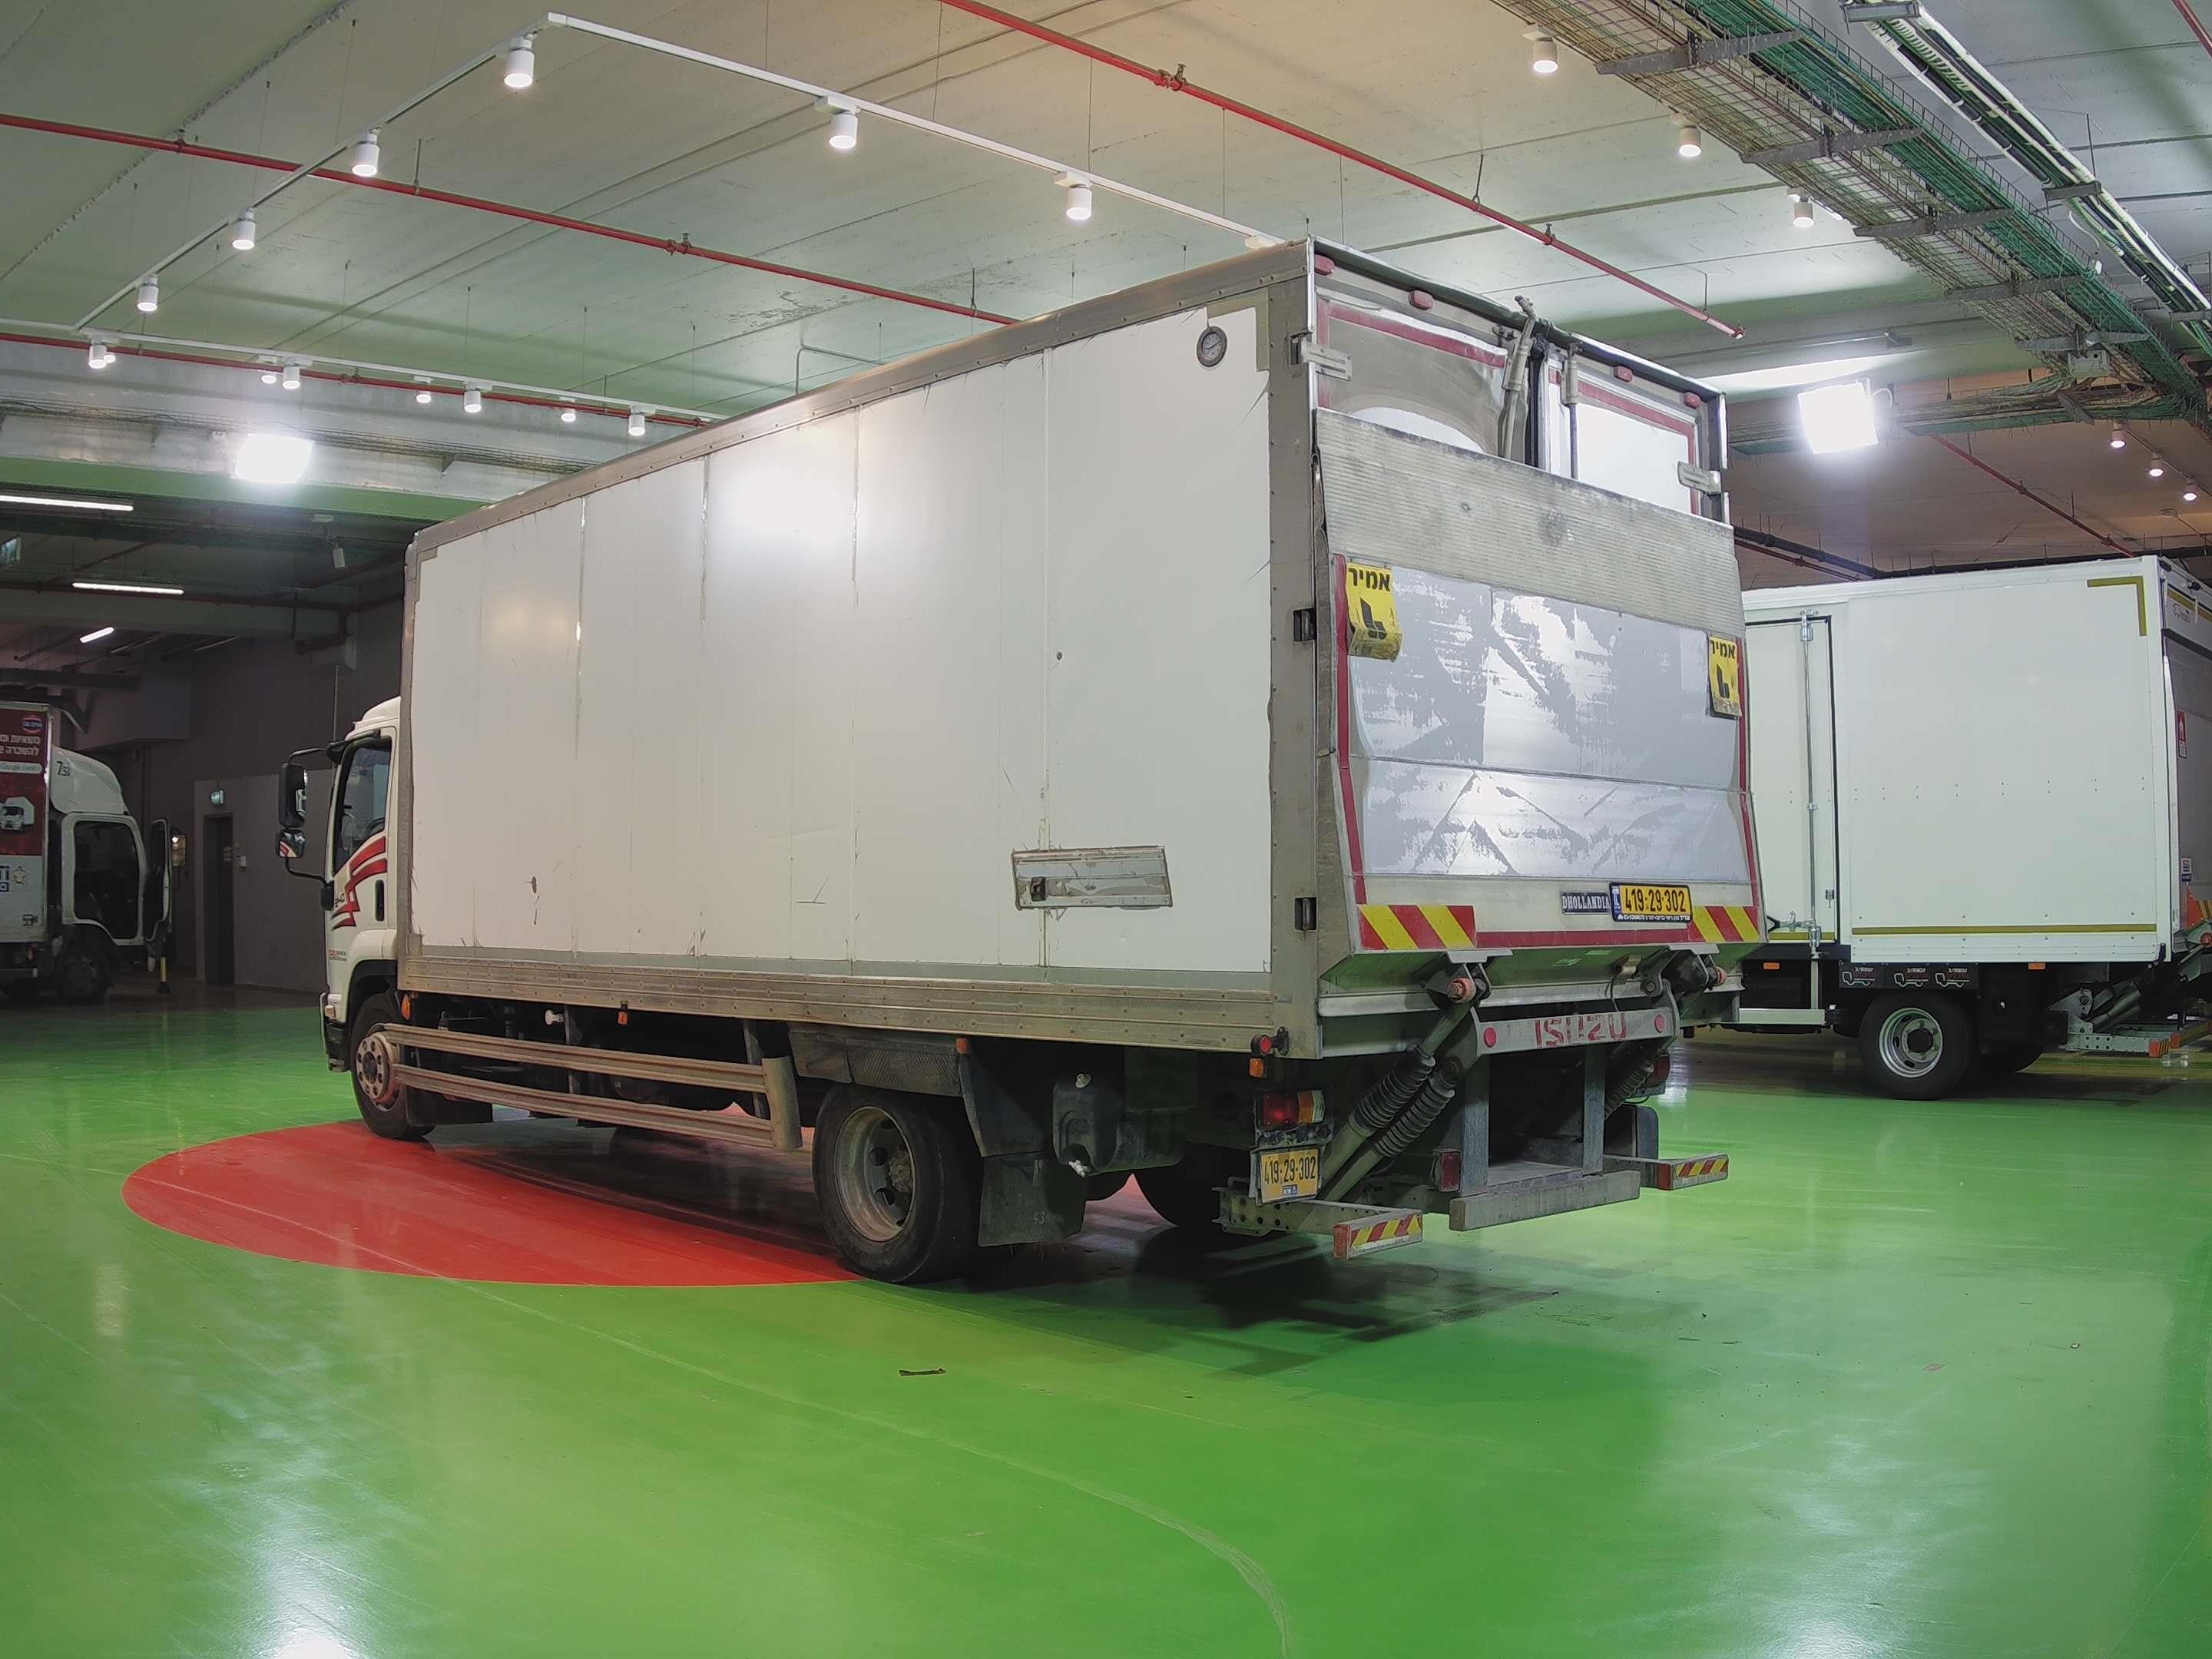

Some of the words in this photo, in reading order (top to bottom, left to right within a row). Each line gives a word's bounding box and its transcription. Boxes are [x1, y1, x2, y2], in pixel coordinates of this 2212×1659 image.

[1349, 568, 1390, 591] אמיר
[1710, 640, 1736, 659] אמיר
[1561, 896, 1611, 909] DHOLLANDIA
[1535, 1012, 1627, 1047] ISUZU
